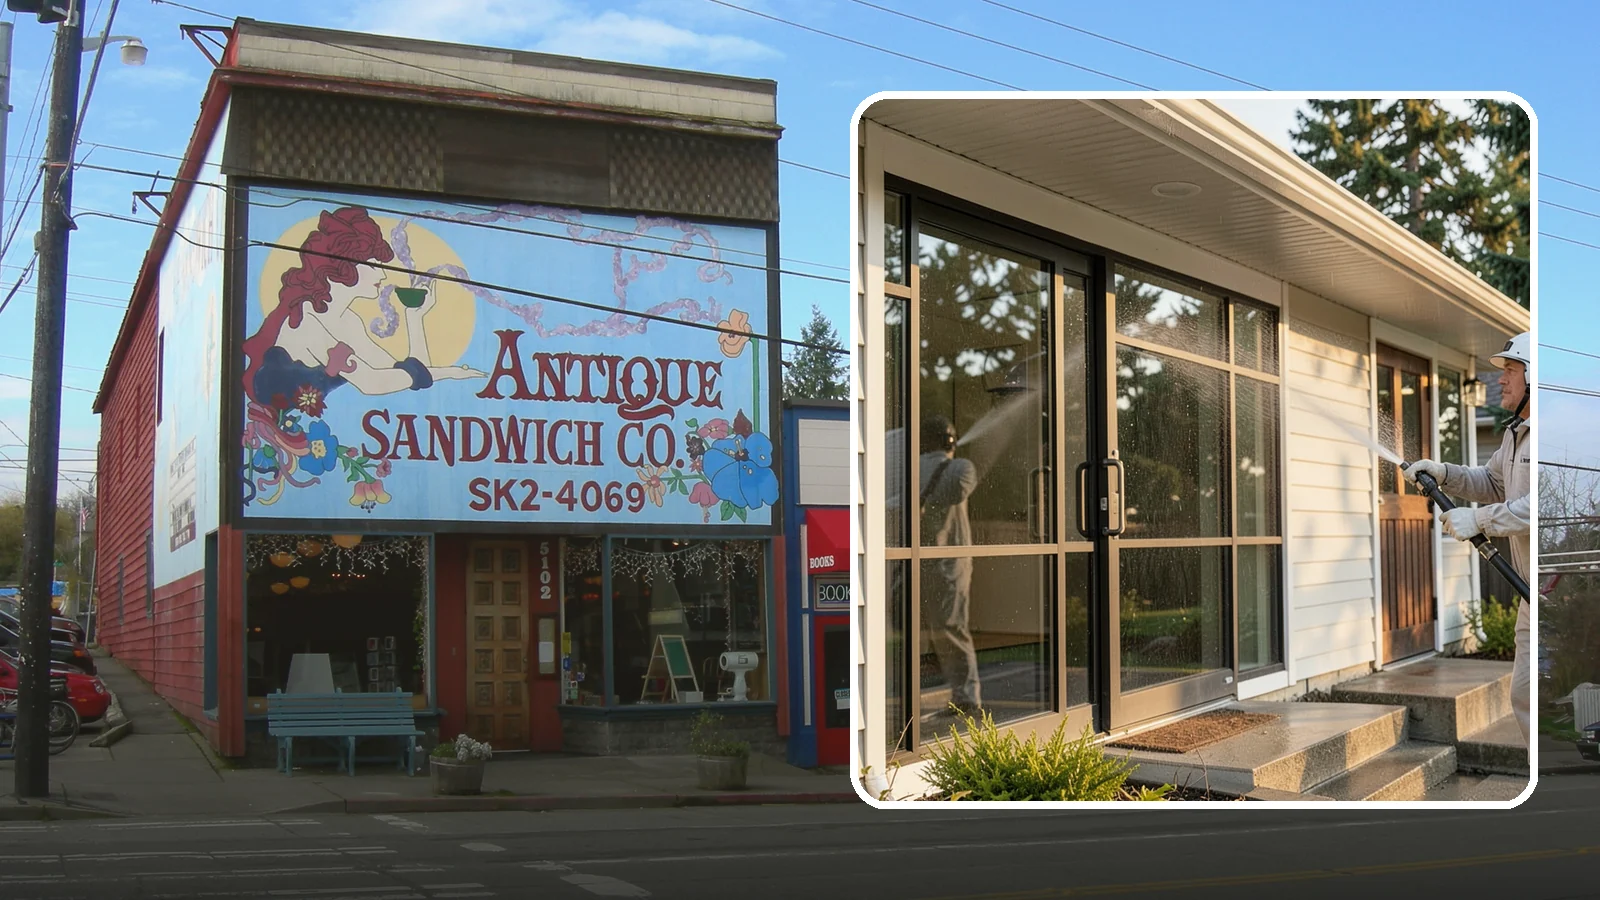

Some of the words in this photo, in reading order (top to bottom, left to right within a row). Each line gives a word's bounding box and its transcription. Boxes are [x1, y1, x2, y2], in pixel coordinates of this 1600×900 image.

[475, 329, 723, 421] ANTIQUE
[361, 408, 604, 467] SANDWICH
[617, 422, 685, 468] CO.
[468, 477, 645, 513] SK2-4069
[540, 541, 551, 600] 5102
[809, 555, 835, 569] BOOKS
